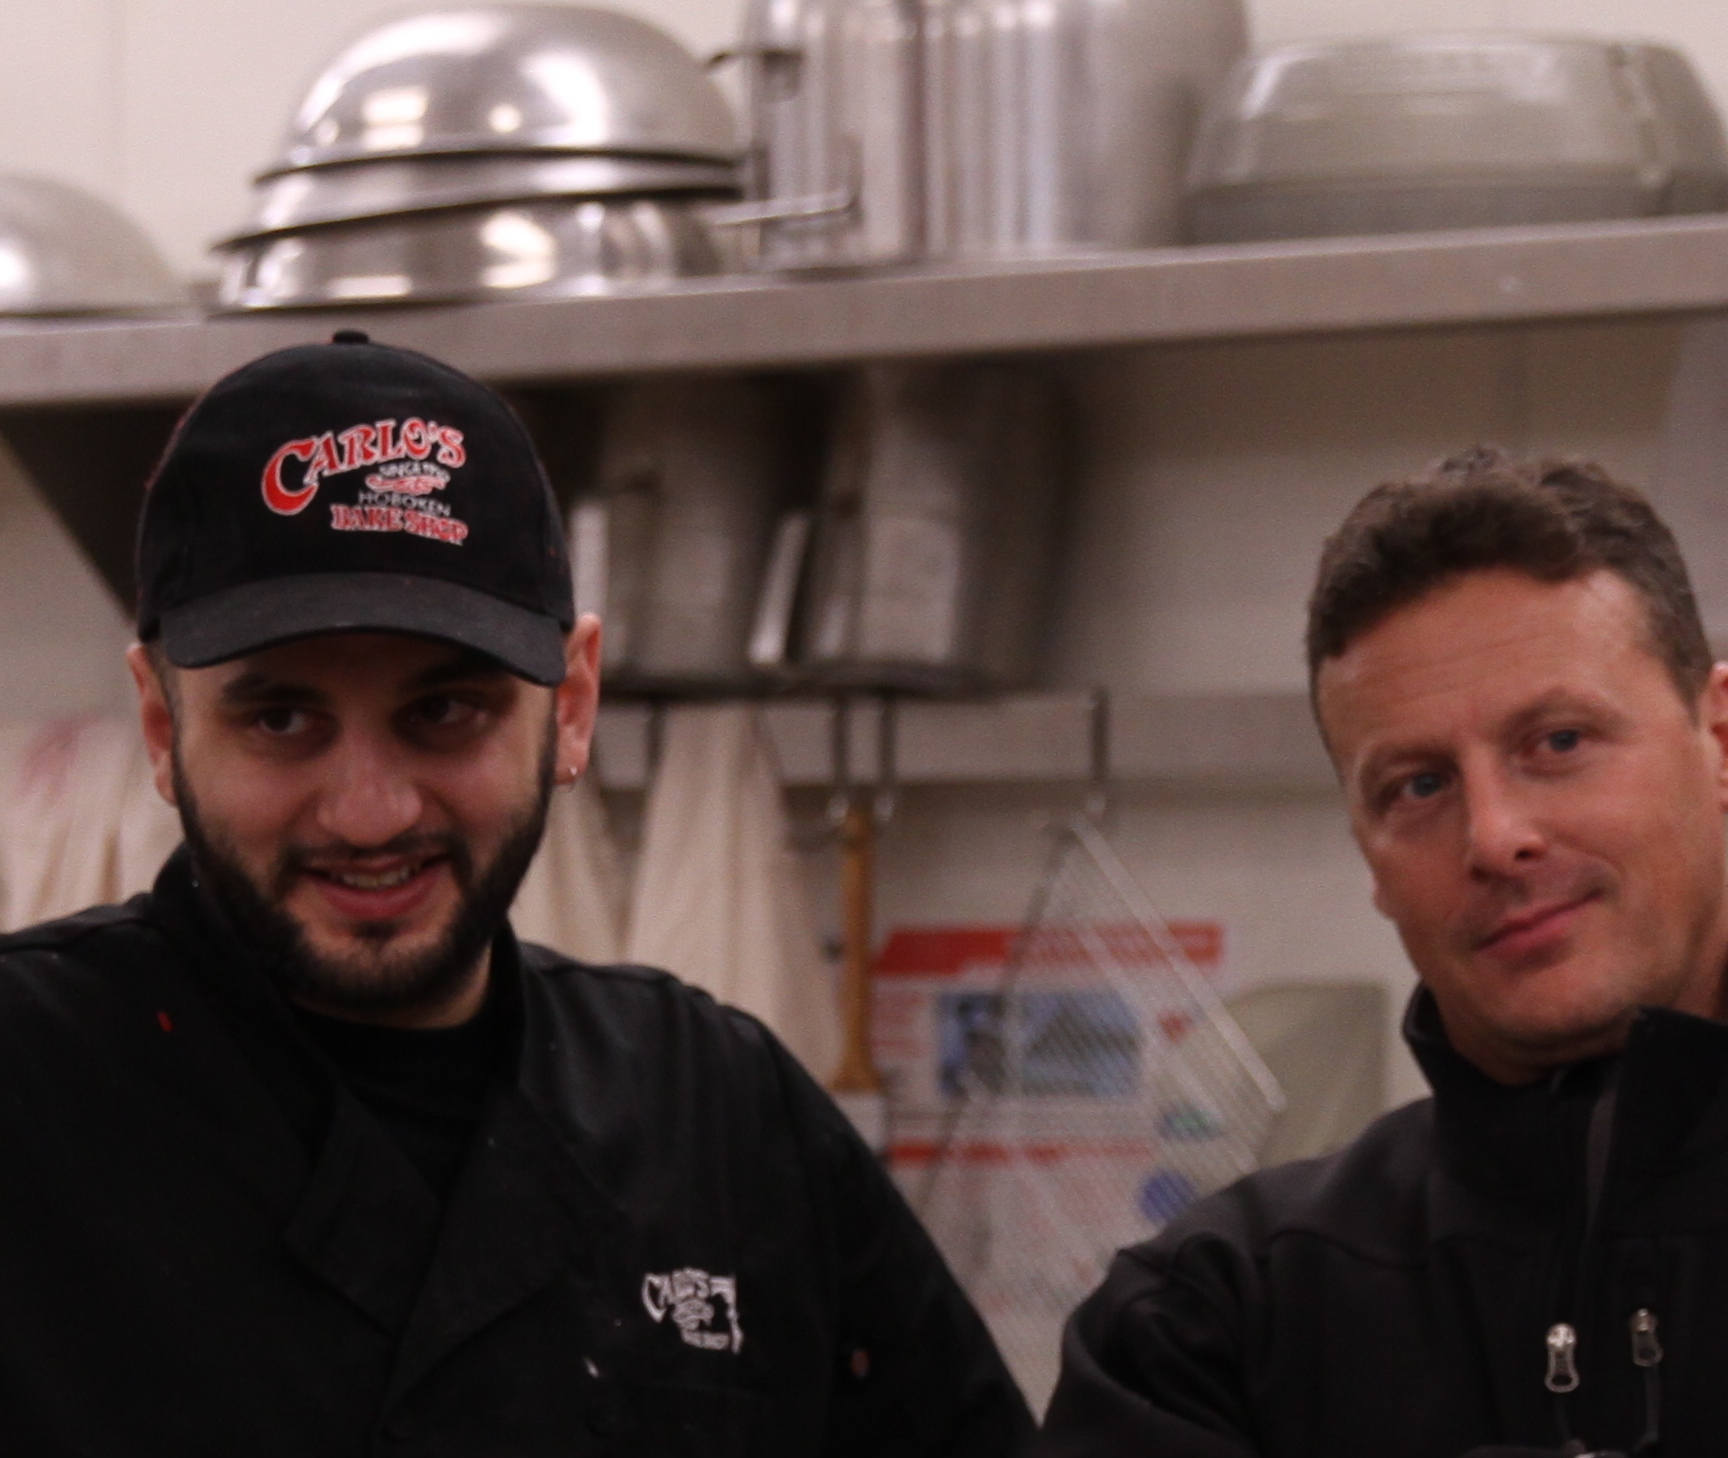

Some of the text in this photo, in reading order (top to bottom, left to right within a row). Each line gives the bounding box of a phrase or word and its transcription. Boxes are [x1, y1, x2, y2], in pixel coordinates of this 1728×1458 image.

[261, 417, 467, 516] CARLO'S
[330, 503, 469, 546] BAKE SHOP
[358, 490, 451, 518] HOBOKEN
